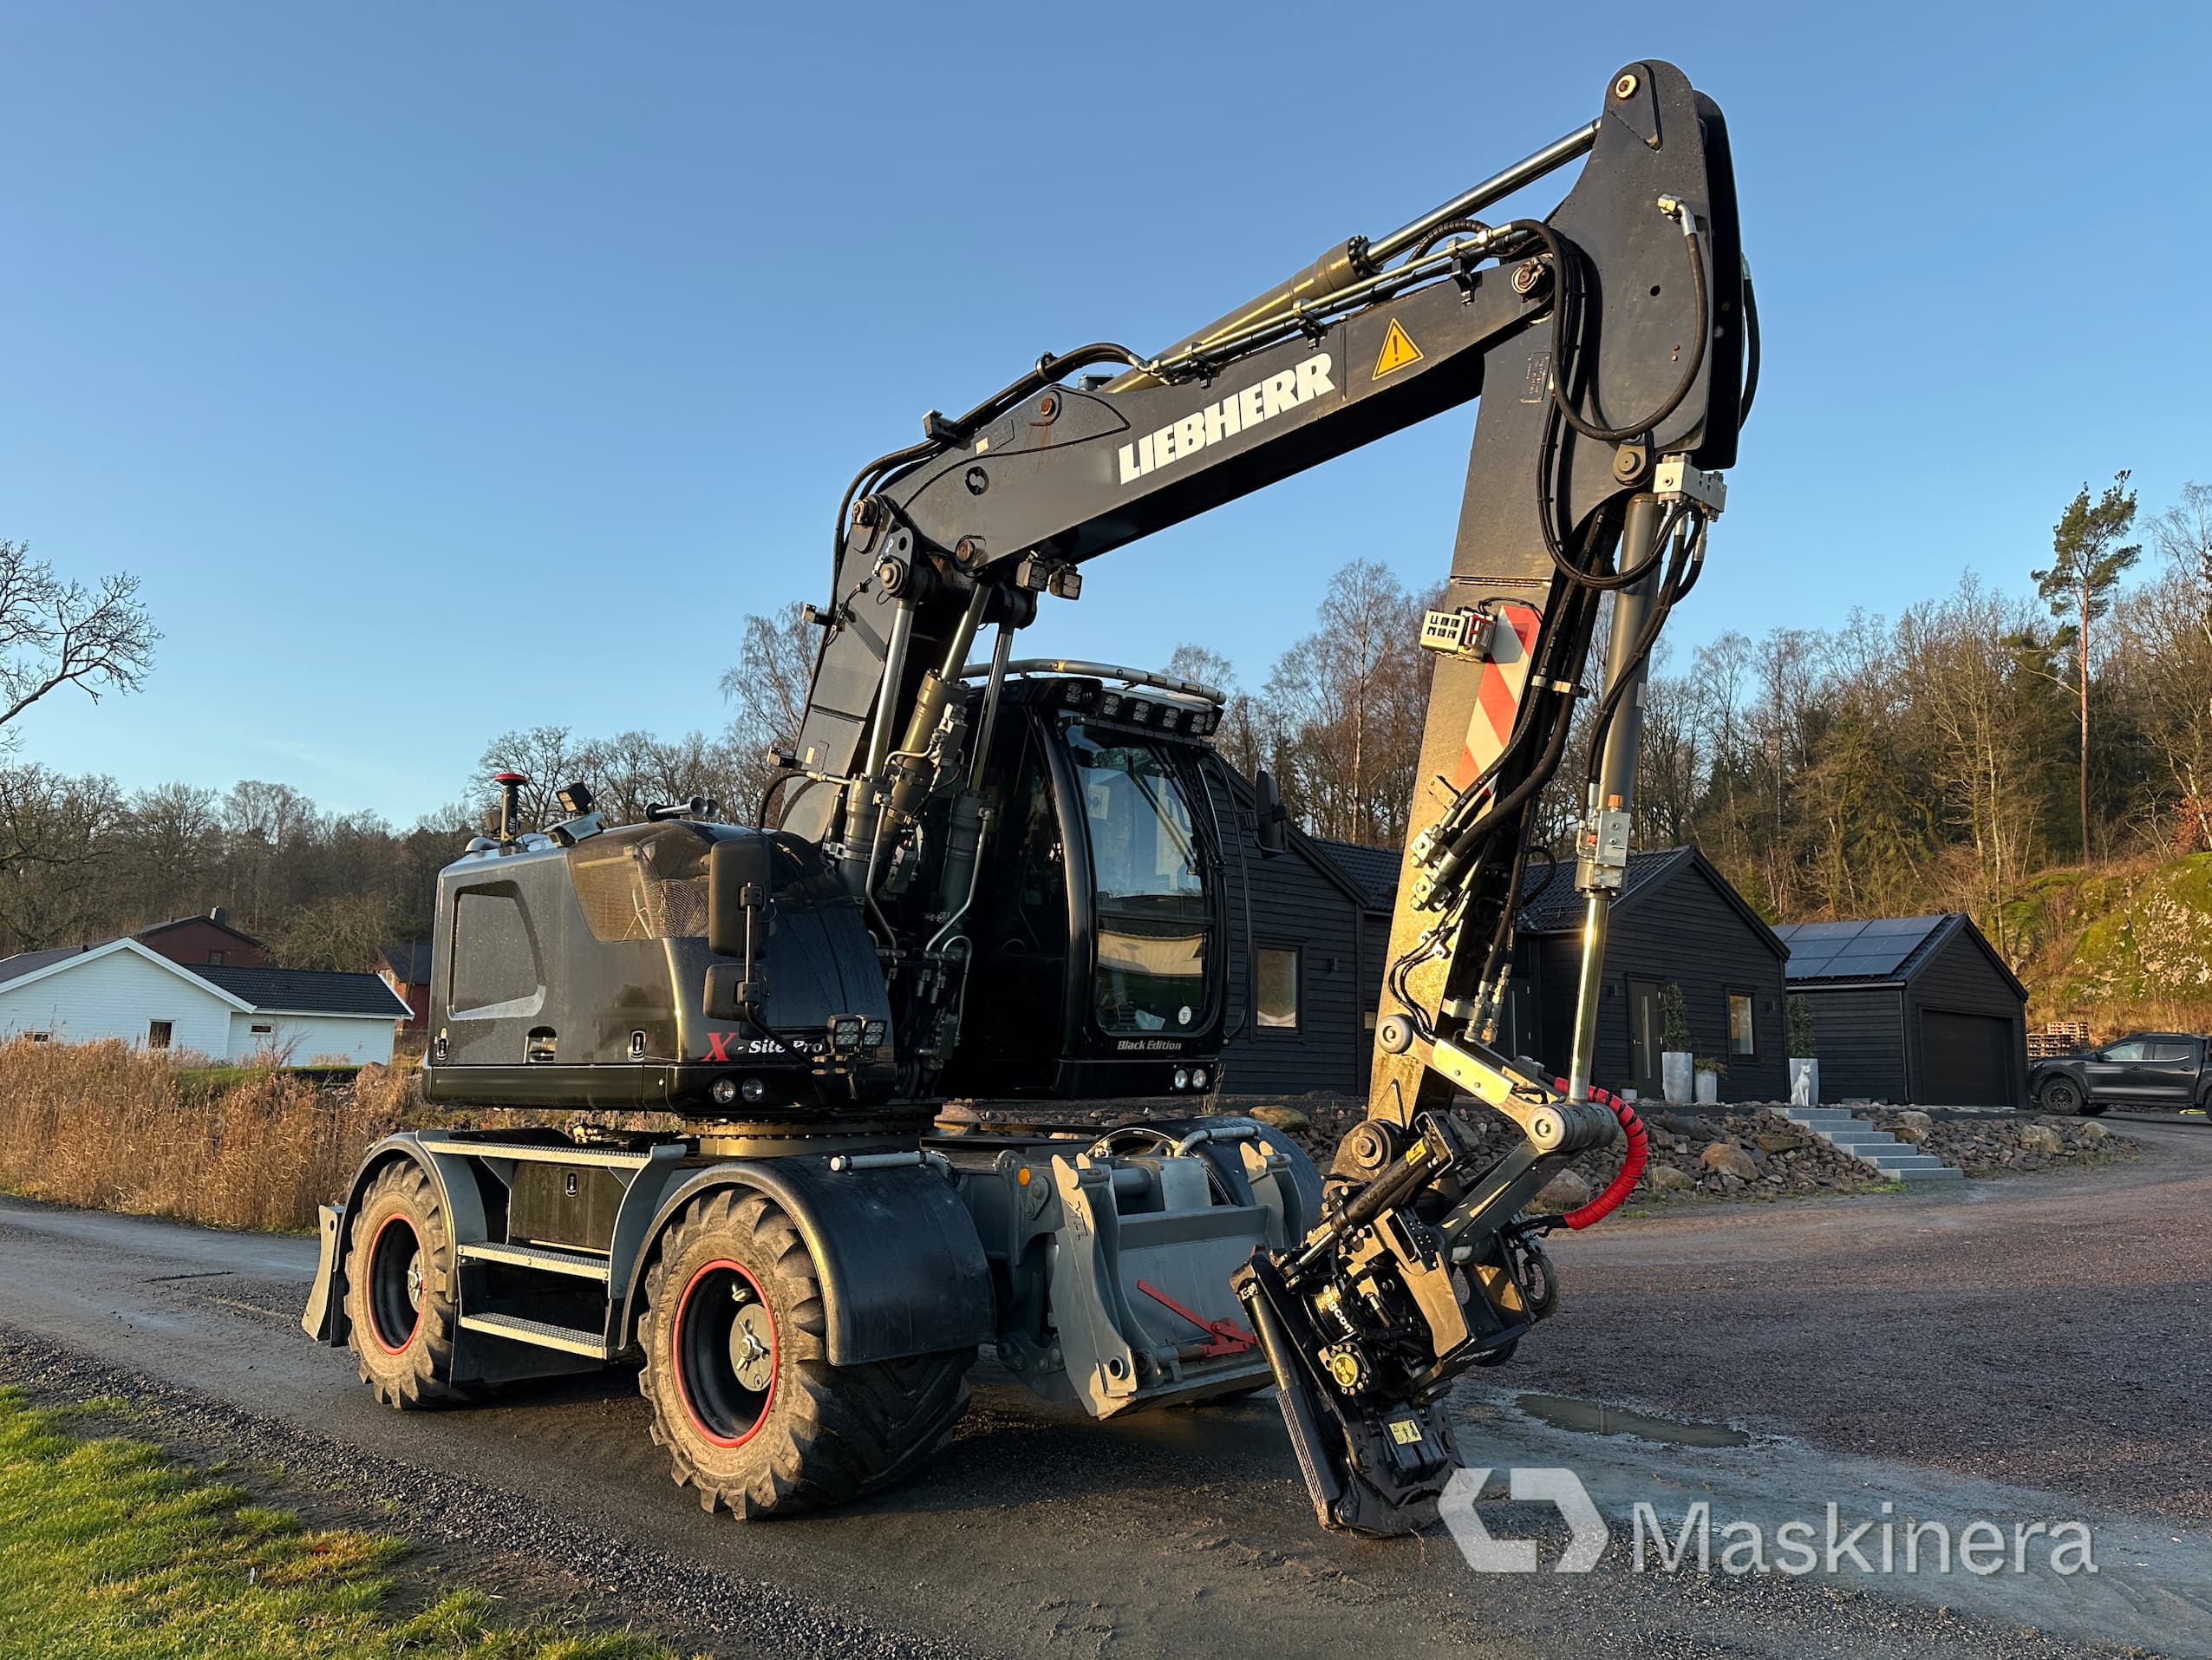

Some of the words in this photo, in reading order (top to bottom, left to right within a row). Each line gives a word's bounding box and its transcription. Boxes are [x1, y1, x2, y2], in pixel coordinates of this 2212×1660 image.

[1119, 352, 1335, 485] LIEBHERR
[701, 1032, 737, 1062] X
[748, 1038, 786, 1054] Site
[793, 1040, 823, 1053] Pro
[1117, 1040, 1145, 1050] Black
[1146, 1040, 1182, 1050] Edition
